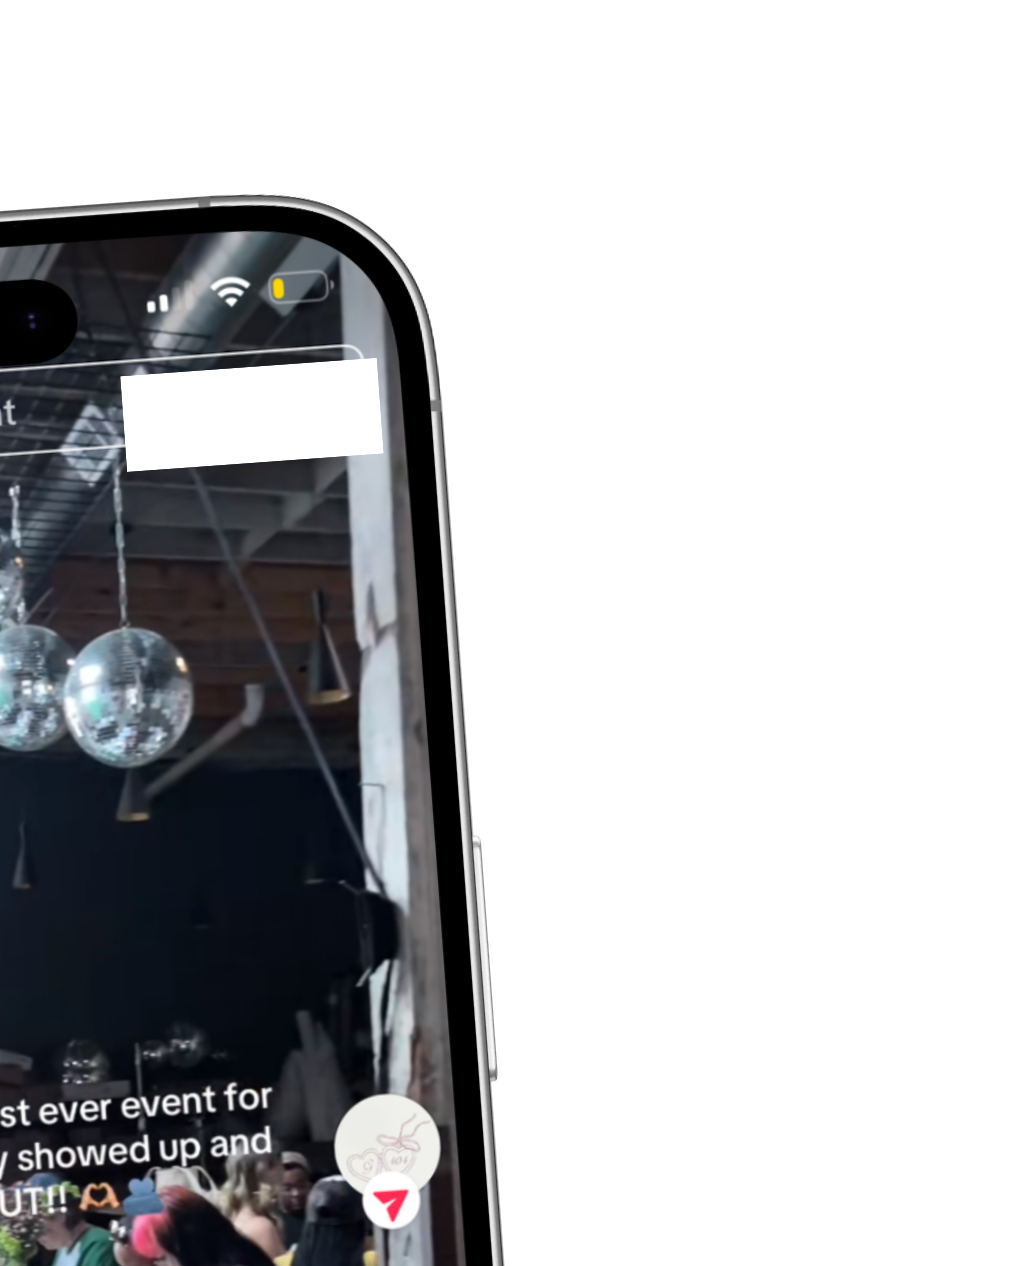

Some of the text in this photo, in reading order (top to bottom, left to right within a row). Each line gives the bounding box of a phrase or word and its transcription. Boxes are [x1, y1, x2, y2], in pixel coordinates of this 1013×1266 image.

[38, 1097, 111, 1125] ever
[120, 1085, 216, 1119] event
[223, 1082, 273, 1112] for
[17, 1134, 151, 1172] showed
[158, 1136, 201, 1167] up
[210, 1125, 272, 1157] and
